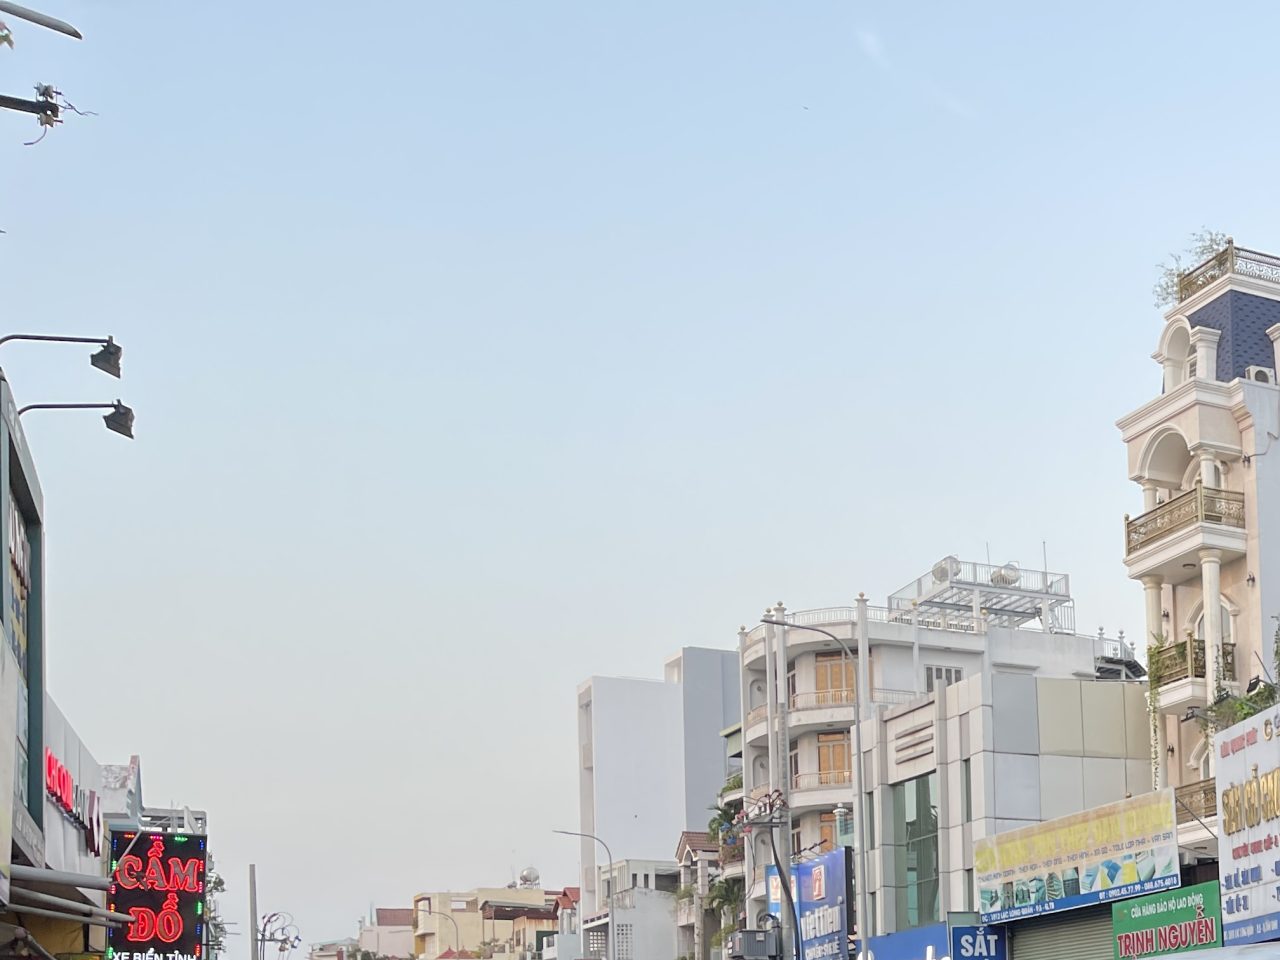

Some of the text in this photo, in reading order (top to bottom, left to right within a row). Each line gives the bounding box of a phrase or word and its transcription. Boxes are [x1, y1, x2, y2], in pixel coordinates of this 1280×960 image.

[115, 841, 200, 892] CẦM
[127, 893, 184, 943] ĐỒ
[1177, 896, 1187, 910] LAO
[960, 927, 999, 957] SẮT
[1117, 928, 1155, 960] TRỊNH
